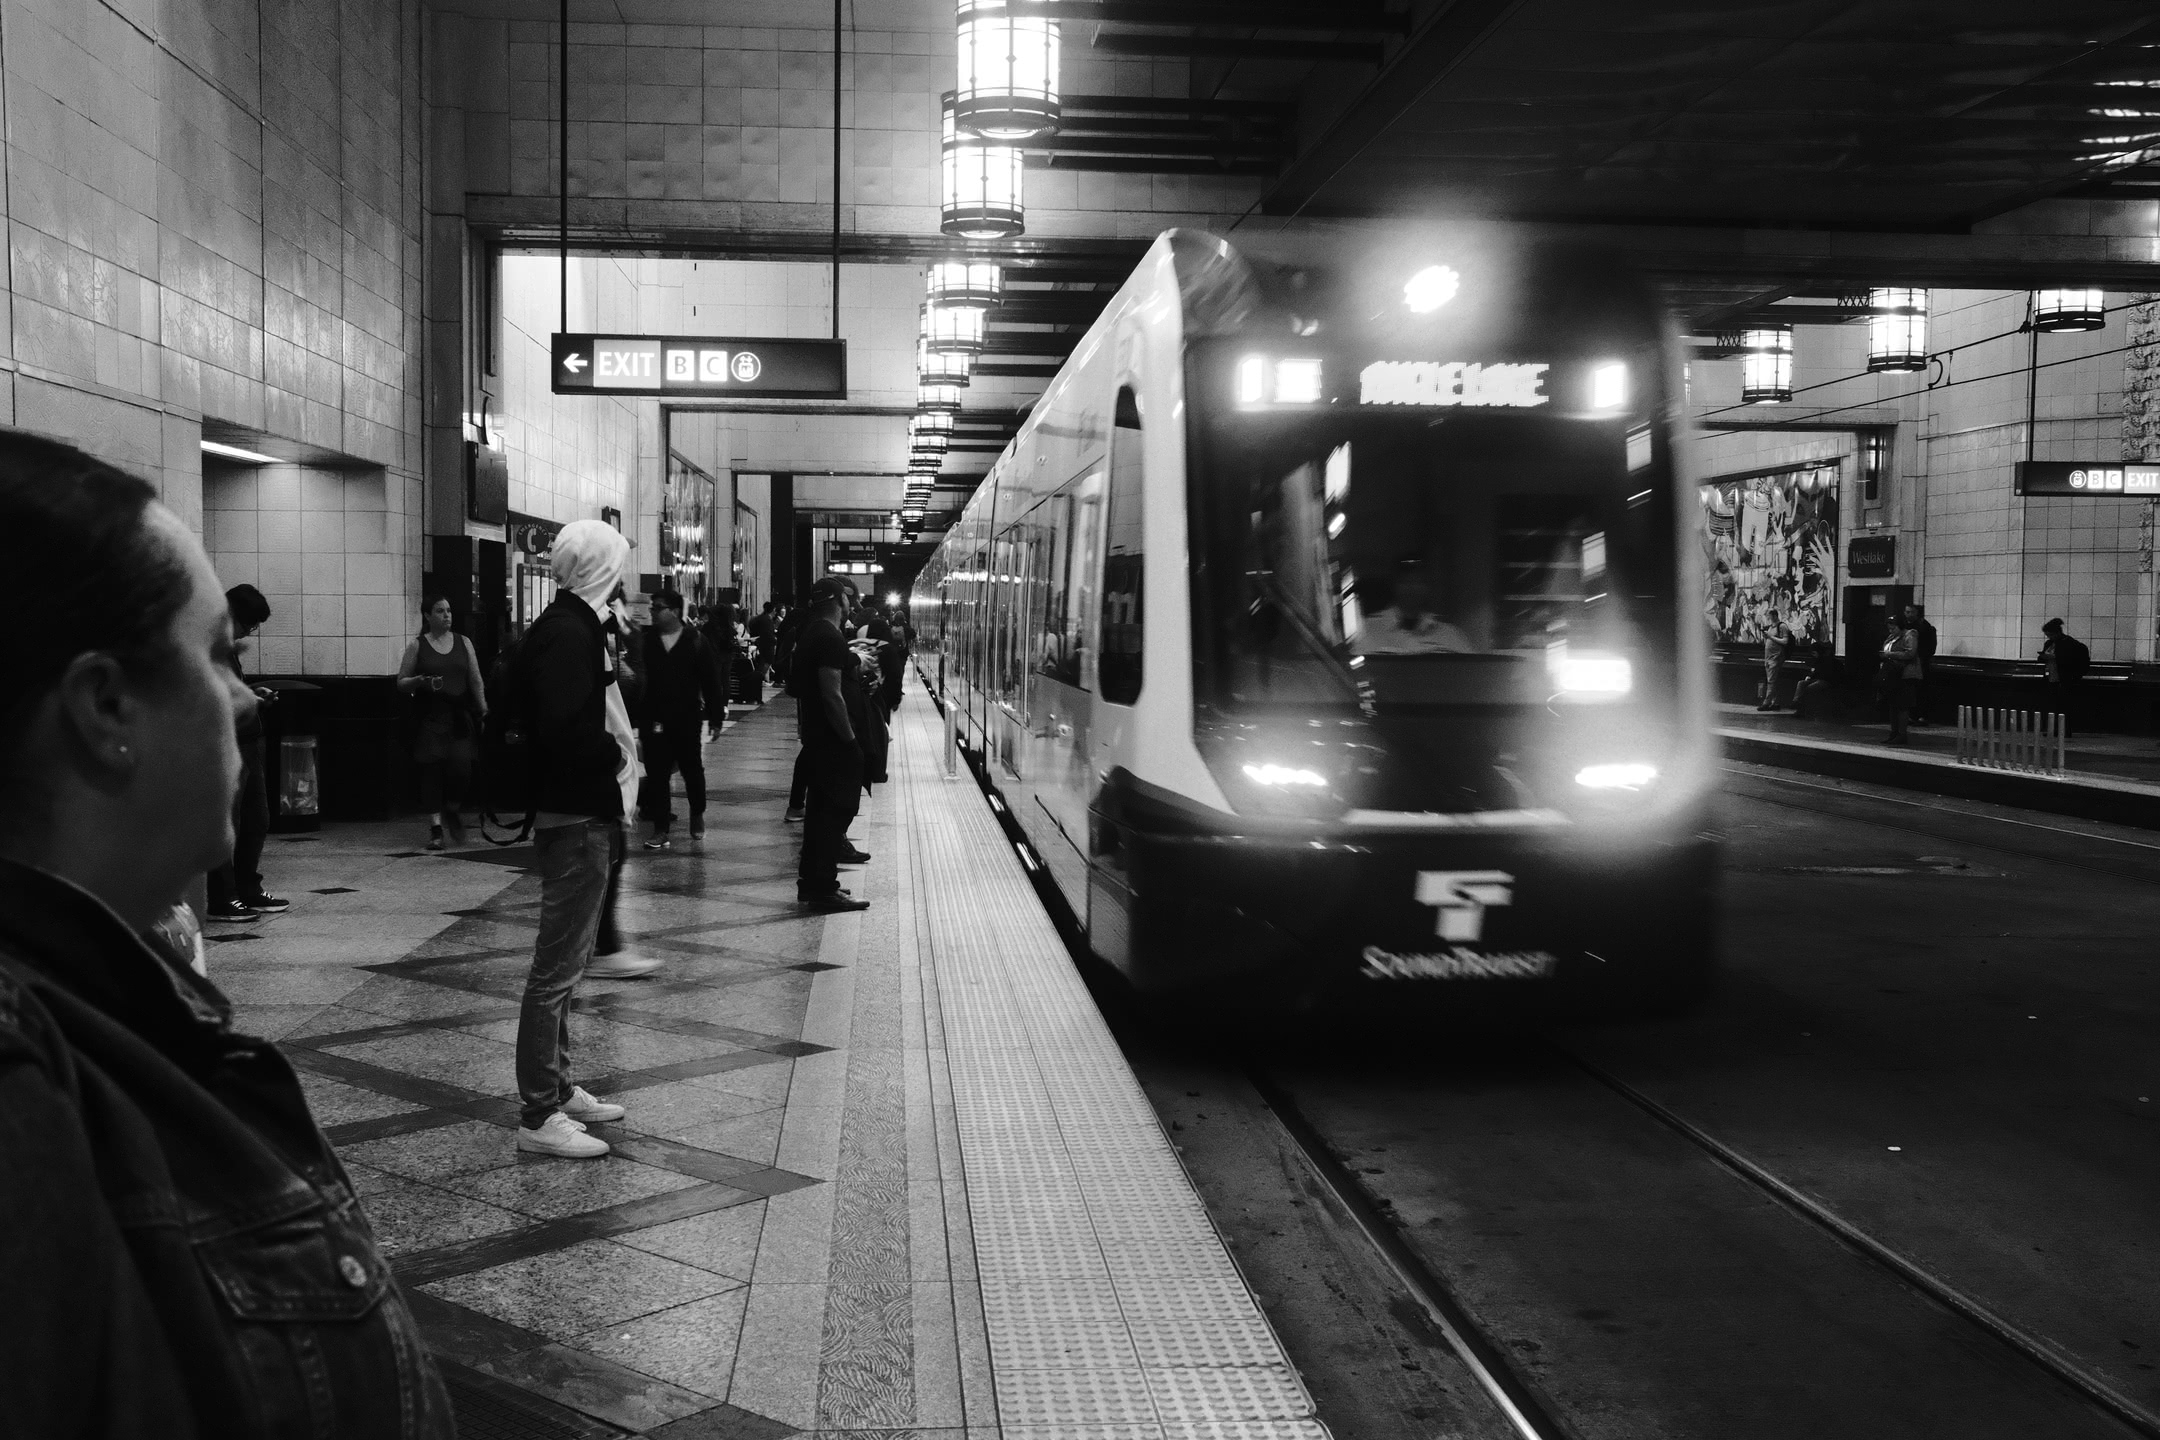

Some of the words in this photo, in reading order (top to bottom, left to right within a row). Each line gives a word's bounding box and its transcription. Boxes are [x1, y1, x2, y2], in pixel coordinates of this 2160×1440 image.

[599, 351, 656, 377] EXIT
[2127, 472, 2159, 487] EXIT
[518, 523, 547, 535] EMERGENCY
[1852, 550, 1886, 565] Westlake
